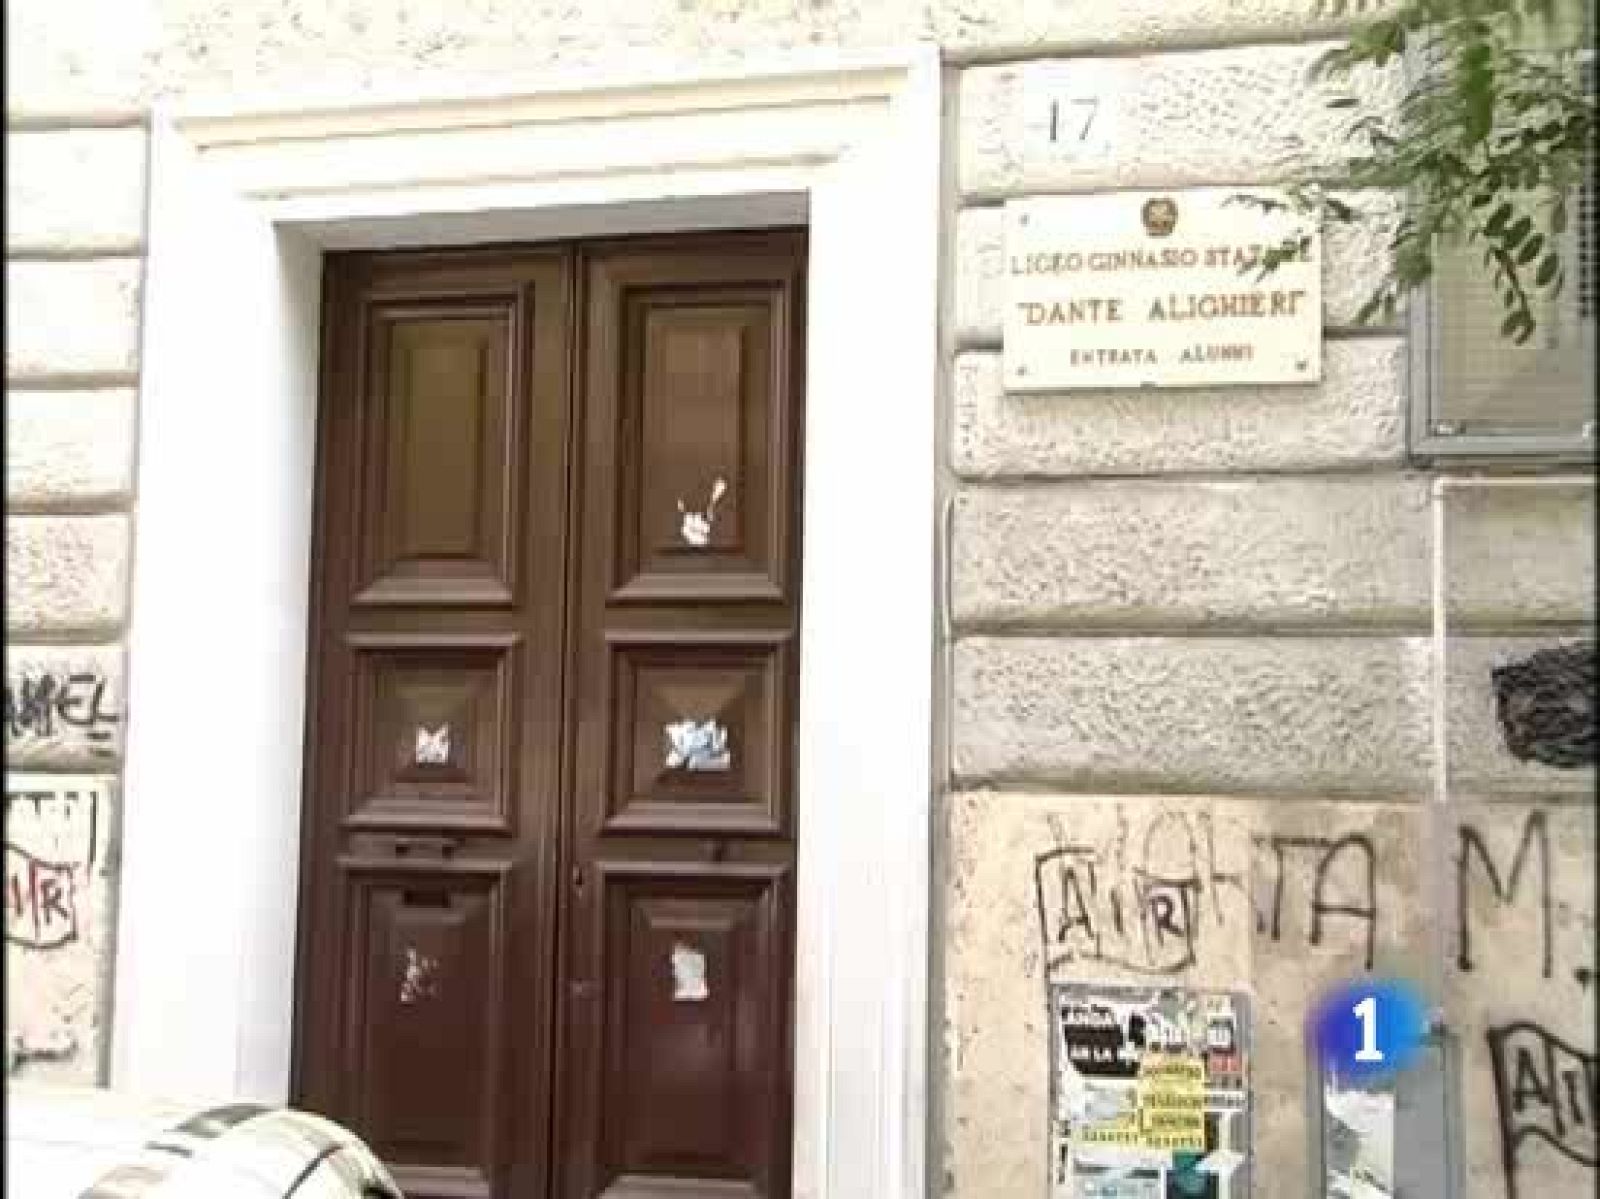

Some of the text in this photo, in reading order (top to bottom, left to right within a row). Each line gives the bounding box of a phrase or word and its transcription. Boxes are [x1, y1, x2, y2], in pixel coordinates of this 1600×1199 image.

[1048, 97, 1099, 142] 17
[1010, 252, 1082, 276] LICEO
[1088, 247, 1198, 271] GINNASIO
[1070, 344, 1254, 367] ENTRATA ALUNNI
